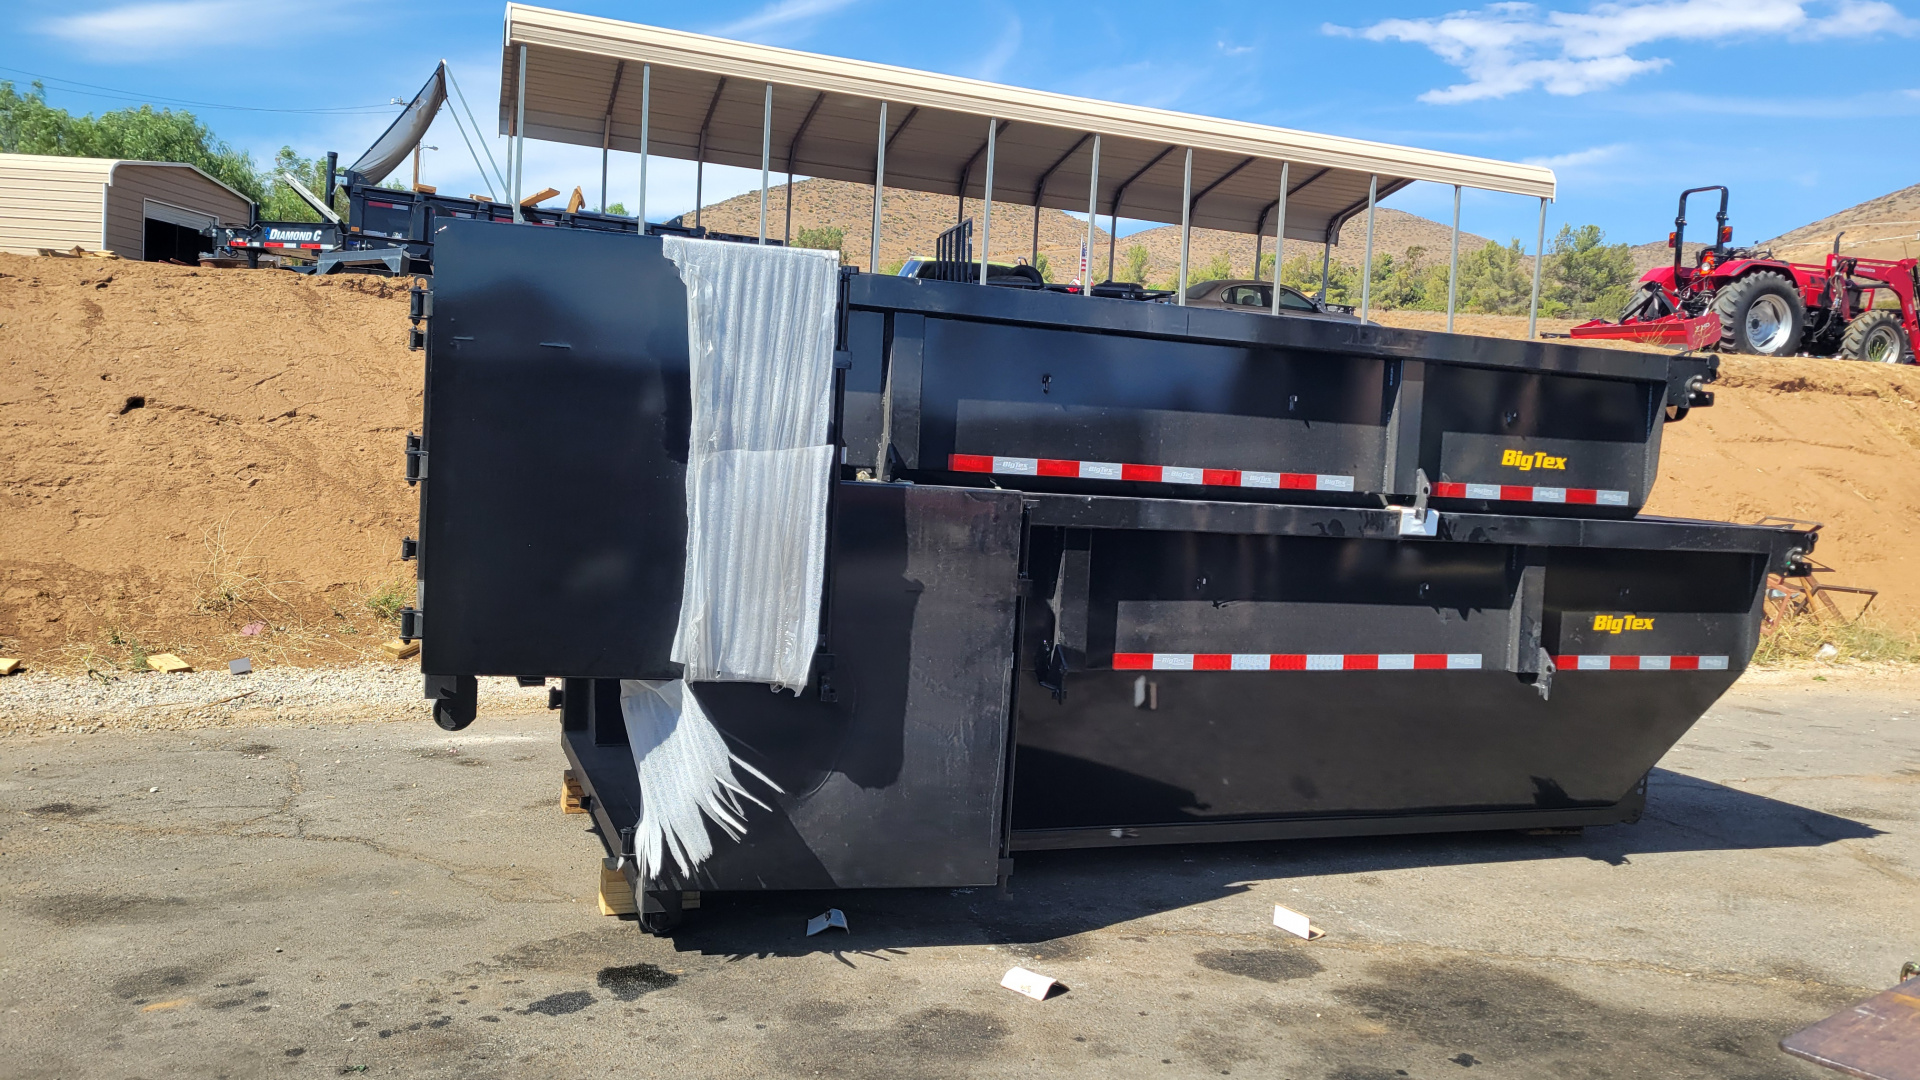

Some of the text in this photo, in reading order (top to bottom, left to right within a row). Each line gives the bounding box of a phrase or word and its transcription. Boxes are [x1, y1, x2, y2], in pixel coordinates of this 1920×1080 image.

[269, 228, 322, 242] DIAMOND C
[1501, 449, 1568, 471] BigTex
[1002, 461, 1029, 470] BigTex
[1088, 466, 1114, 475] BigTex
[1170, 470, 1195, 479] BigTex
[1249, 475, 1273, 484] BigTex
[1324, 478, 1347, 487] BigTex
[1592, 614, 1655, 634] BigTex
